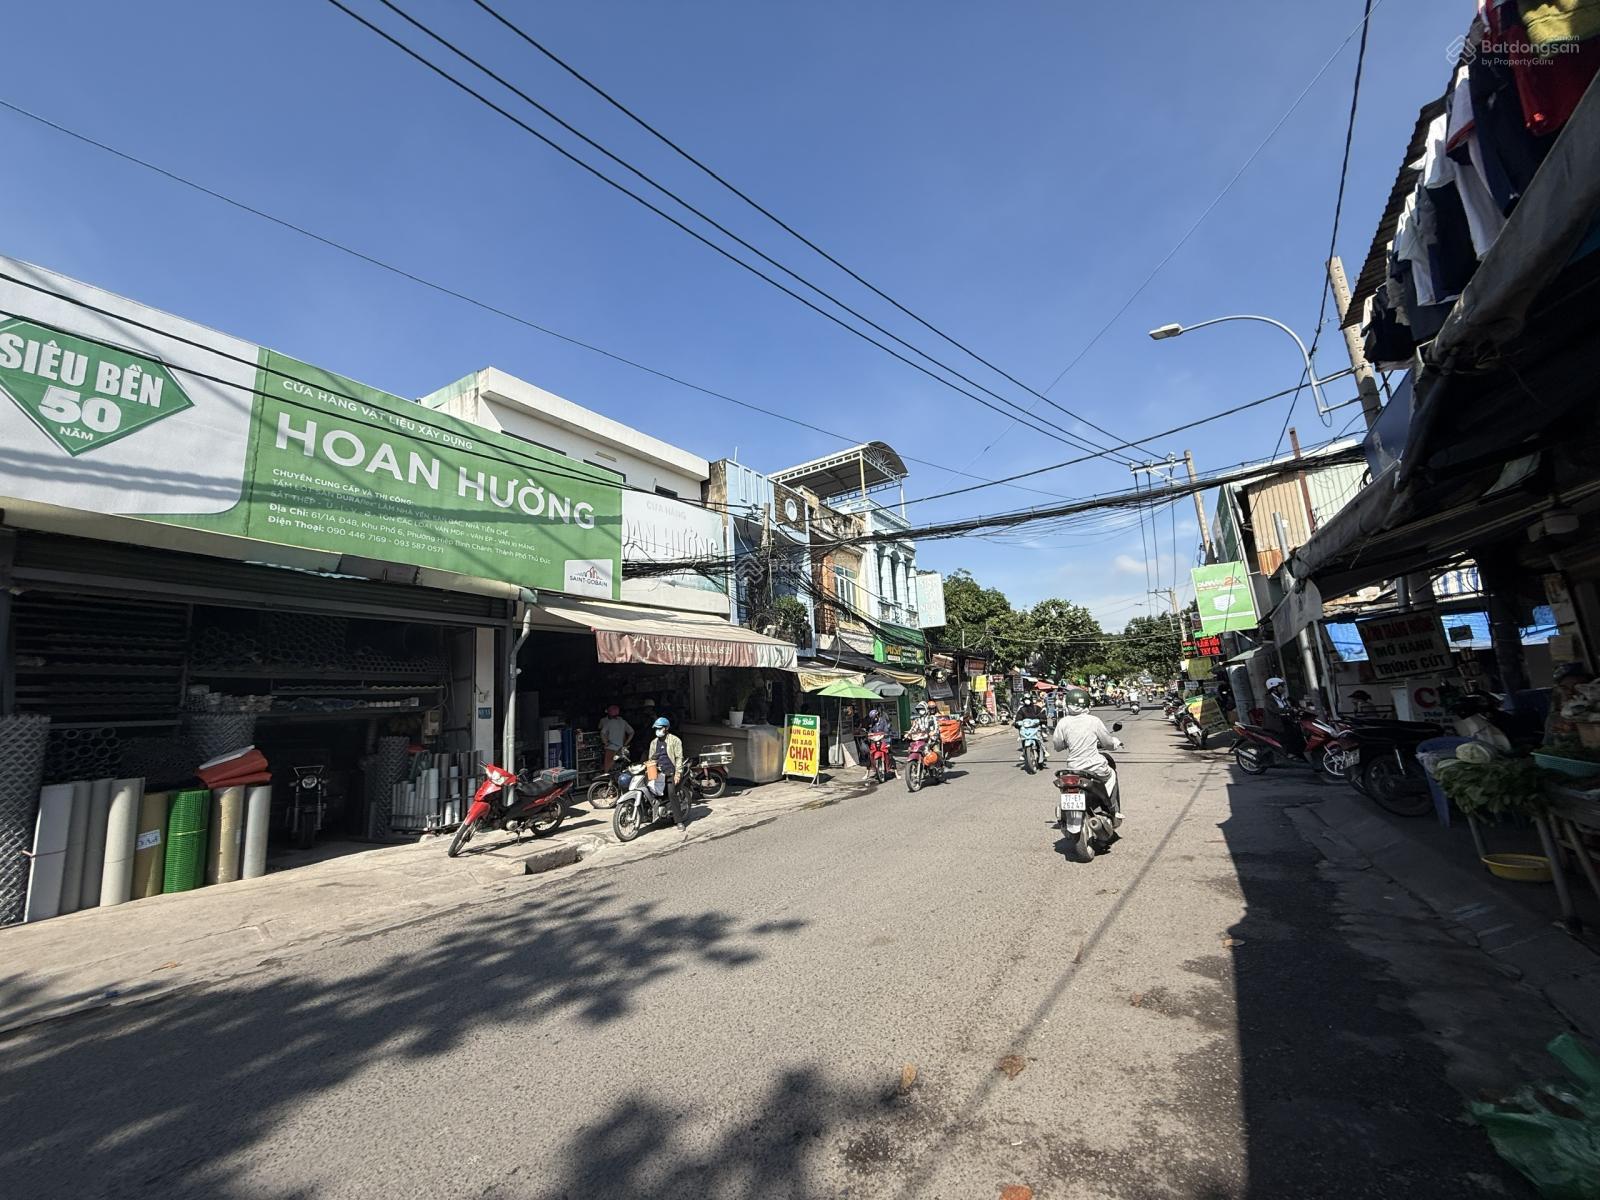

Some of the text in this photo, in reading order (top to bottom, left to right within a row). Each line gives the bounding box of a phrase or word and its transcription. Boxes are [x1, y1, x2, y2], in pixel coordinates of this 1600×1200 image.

[0, 333, 164, 408] SIÊU BỀN
[38, 385, 122, 433] 50
[318, 391, 358, 411] HÀNG
[60, 426, 94, 441] NĂM
[273, 469, 313, 482] CHUYÊN
[315, 478, 340, 489] CUNG
[375, 491, 388, 501] THI
[276, 412, 595, 530] HOAN HƯỜNG
[268, 515, 291, 526] Điện
[326, 526, 346, 536] 090
[348, 530, 366, 540] 446
[269, 503, 286, 513] Địa
[361, 521, 378, 530] Khu
[380, 524, 395, 534] Phố
[790, 746, 814, 761] CHAY
